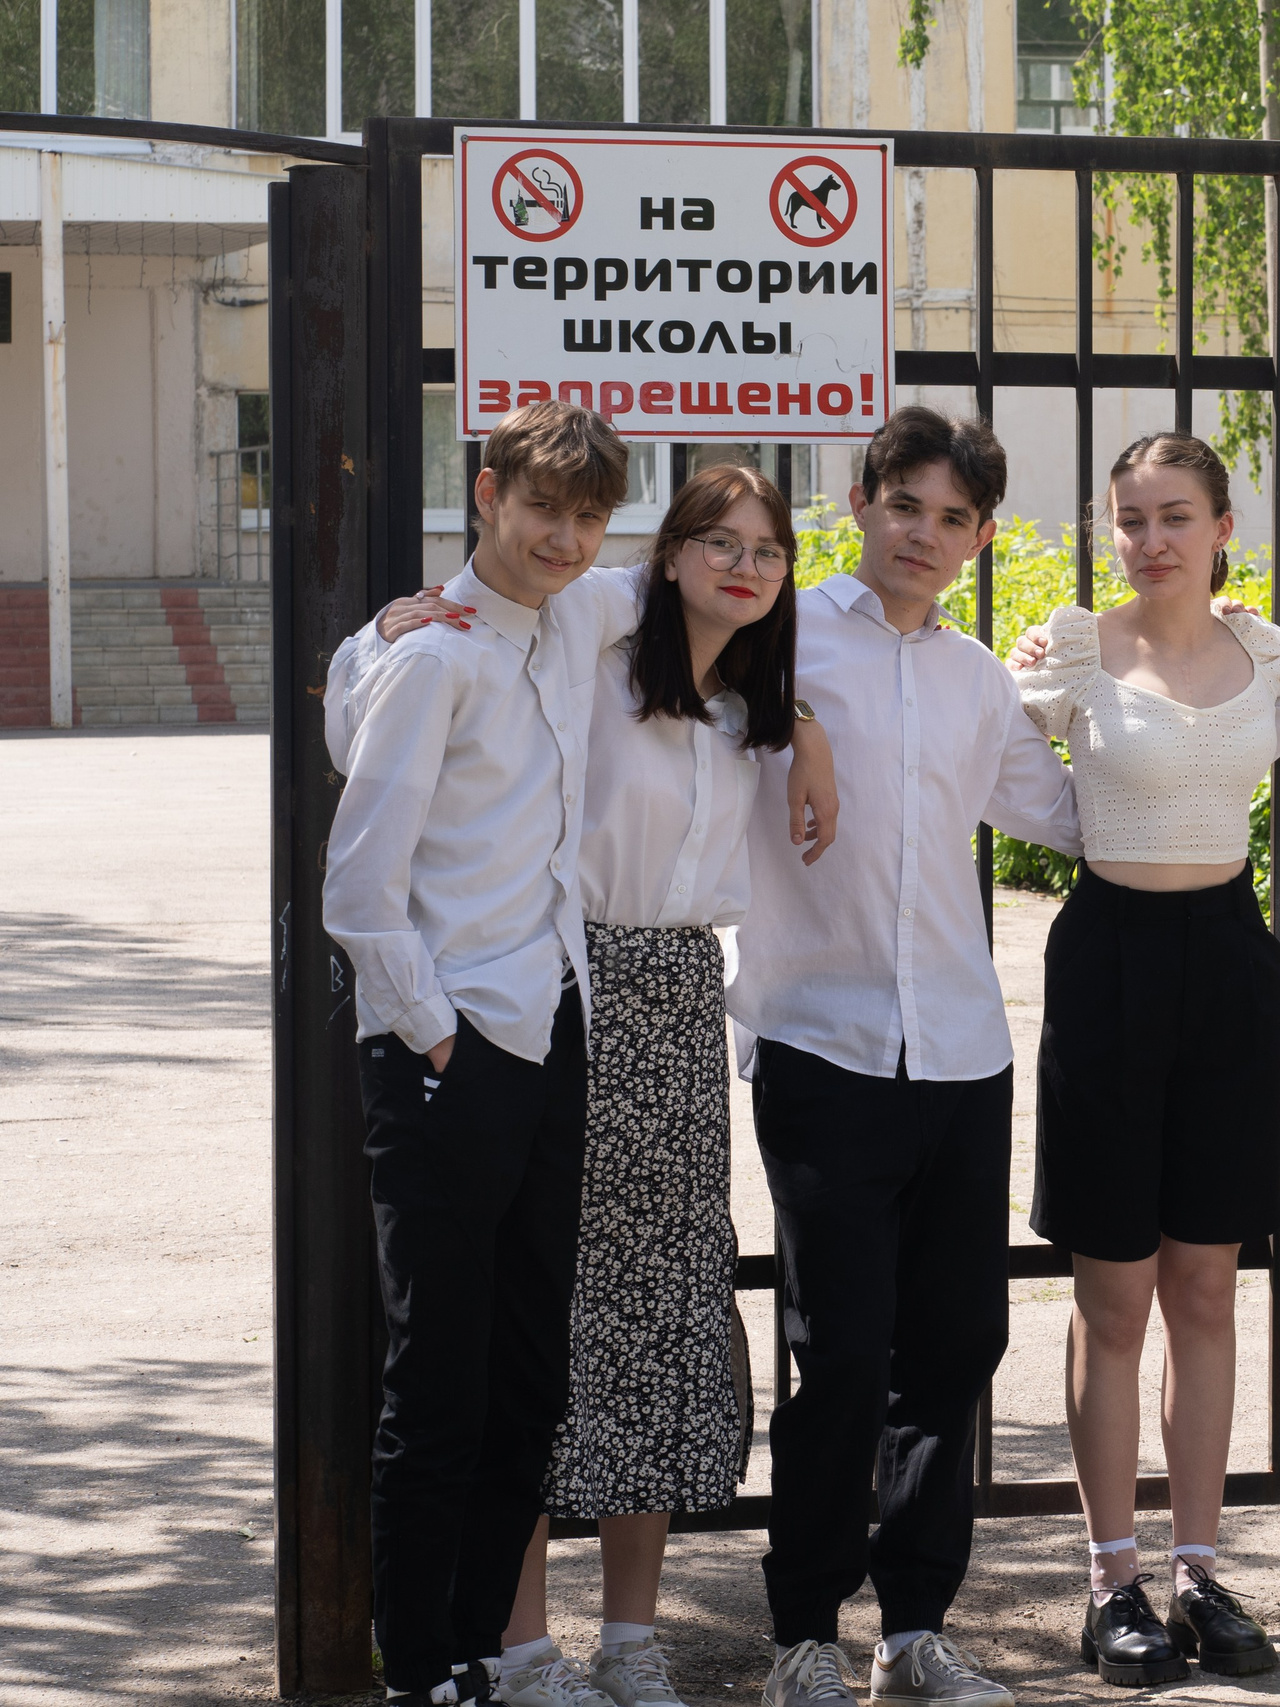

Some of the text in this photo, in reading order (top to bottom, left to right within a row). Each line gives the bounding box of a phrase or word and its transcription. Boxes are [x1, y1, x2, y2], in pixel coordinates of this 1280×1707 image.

[640, 197, 715, 231] на
[473, 255, 877, 303] территории
[563, 318, 791, 354] школы
[479, 373, 874, 424] запрещено!
